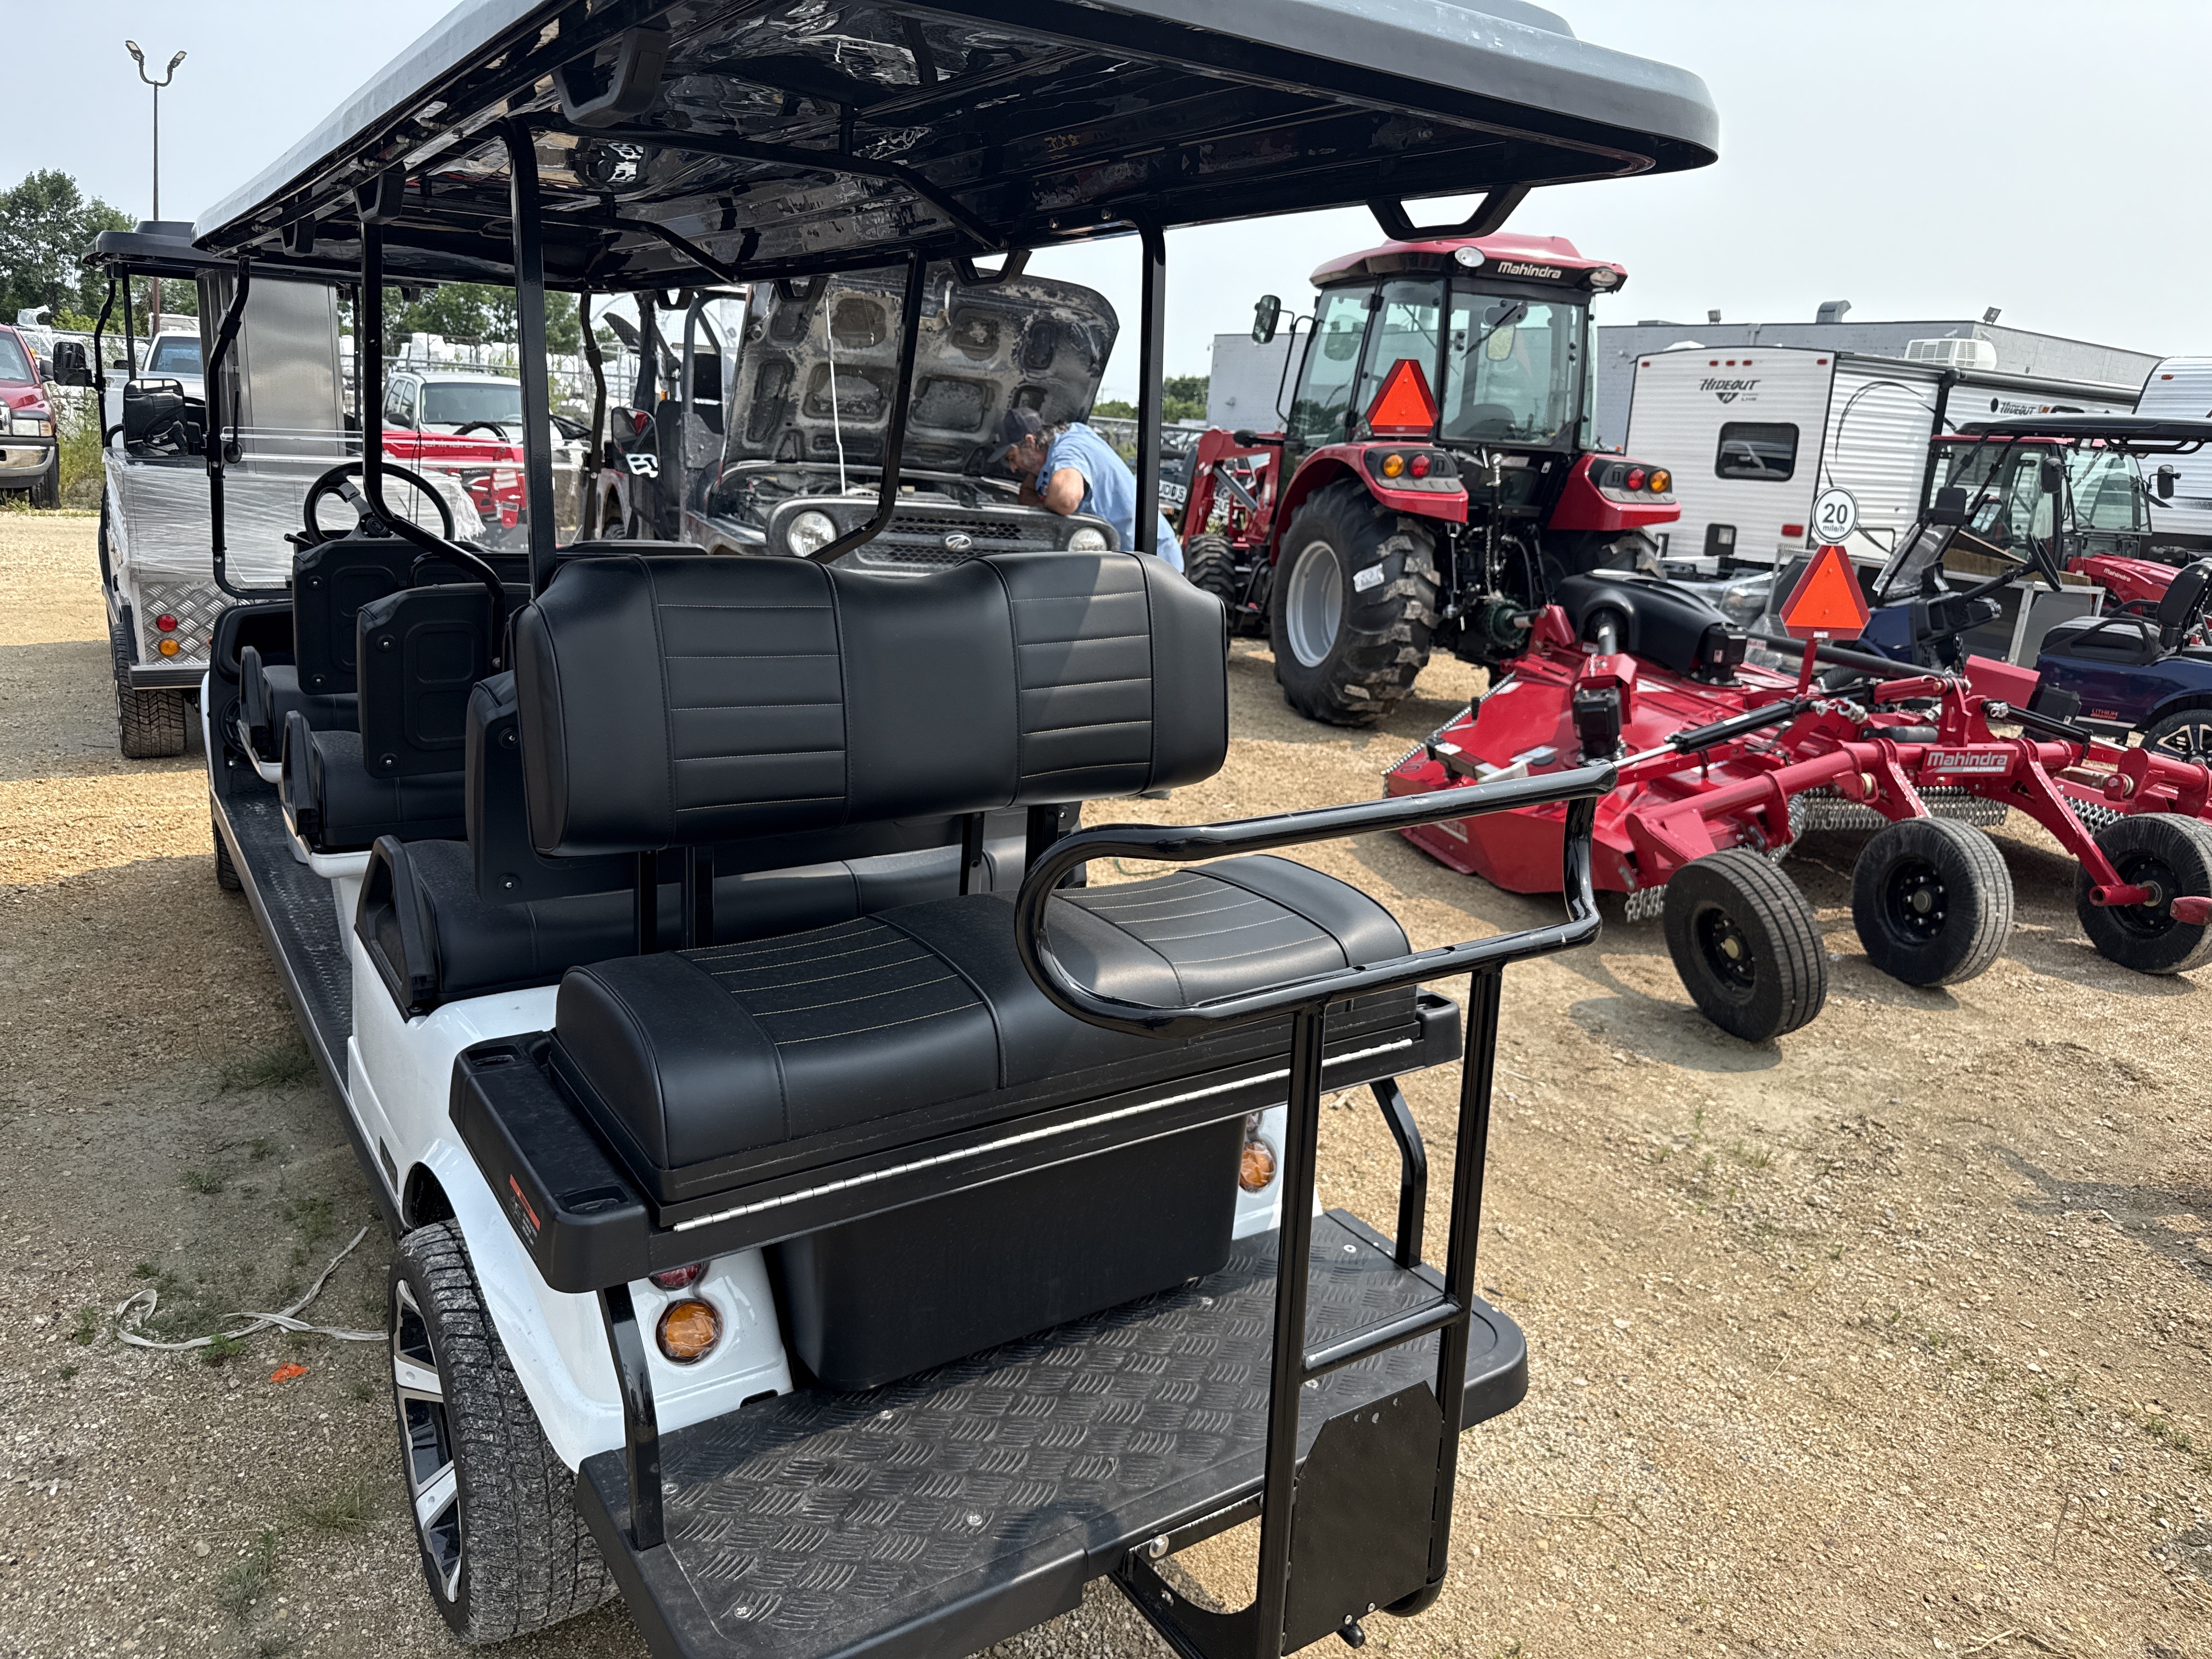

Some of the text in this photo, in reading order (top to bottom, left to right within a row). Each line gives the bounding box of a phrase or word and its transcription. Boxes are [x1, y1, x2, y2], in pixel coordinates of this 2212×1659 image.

[1497, 261, 1562, 279] Mahindra
[1700, 378, 1760, 391] HIDEOUT
[1822, 503, 1848, 524] 20
[1927, 751, 2008, 766] Mahindra
